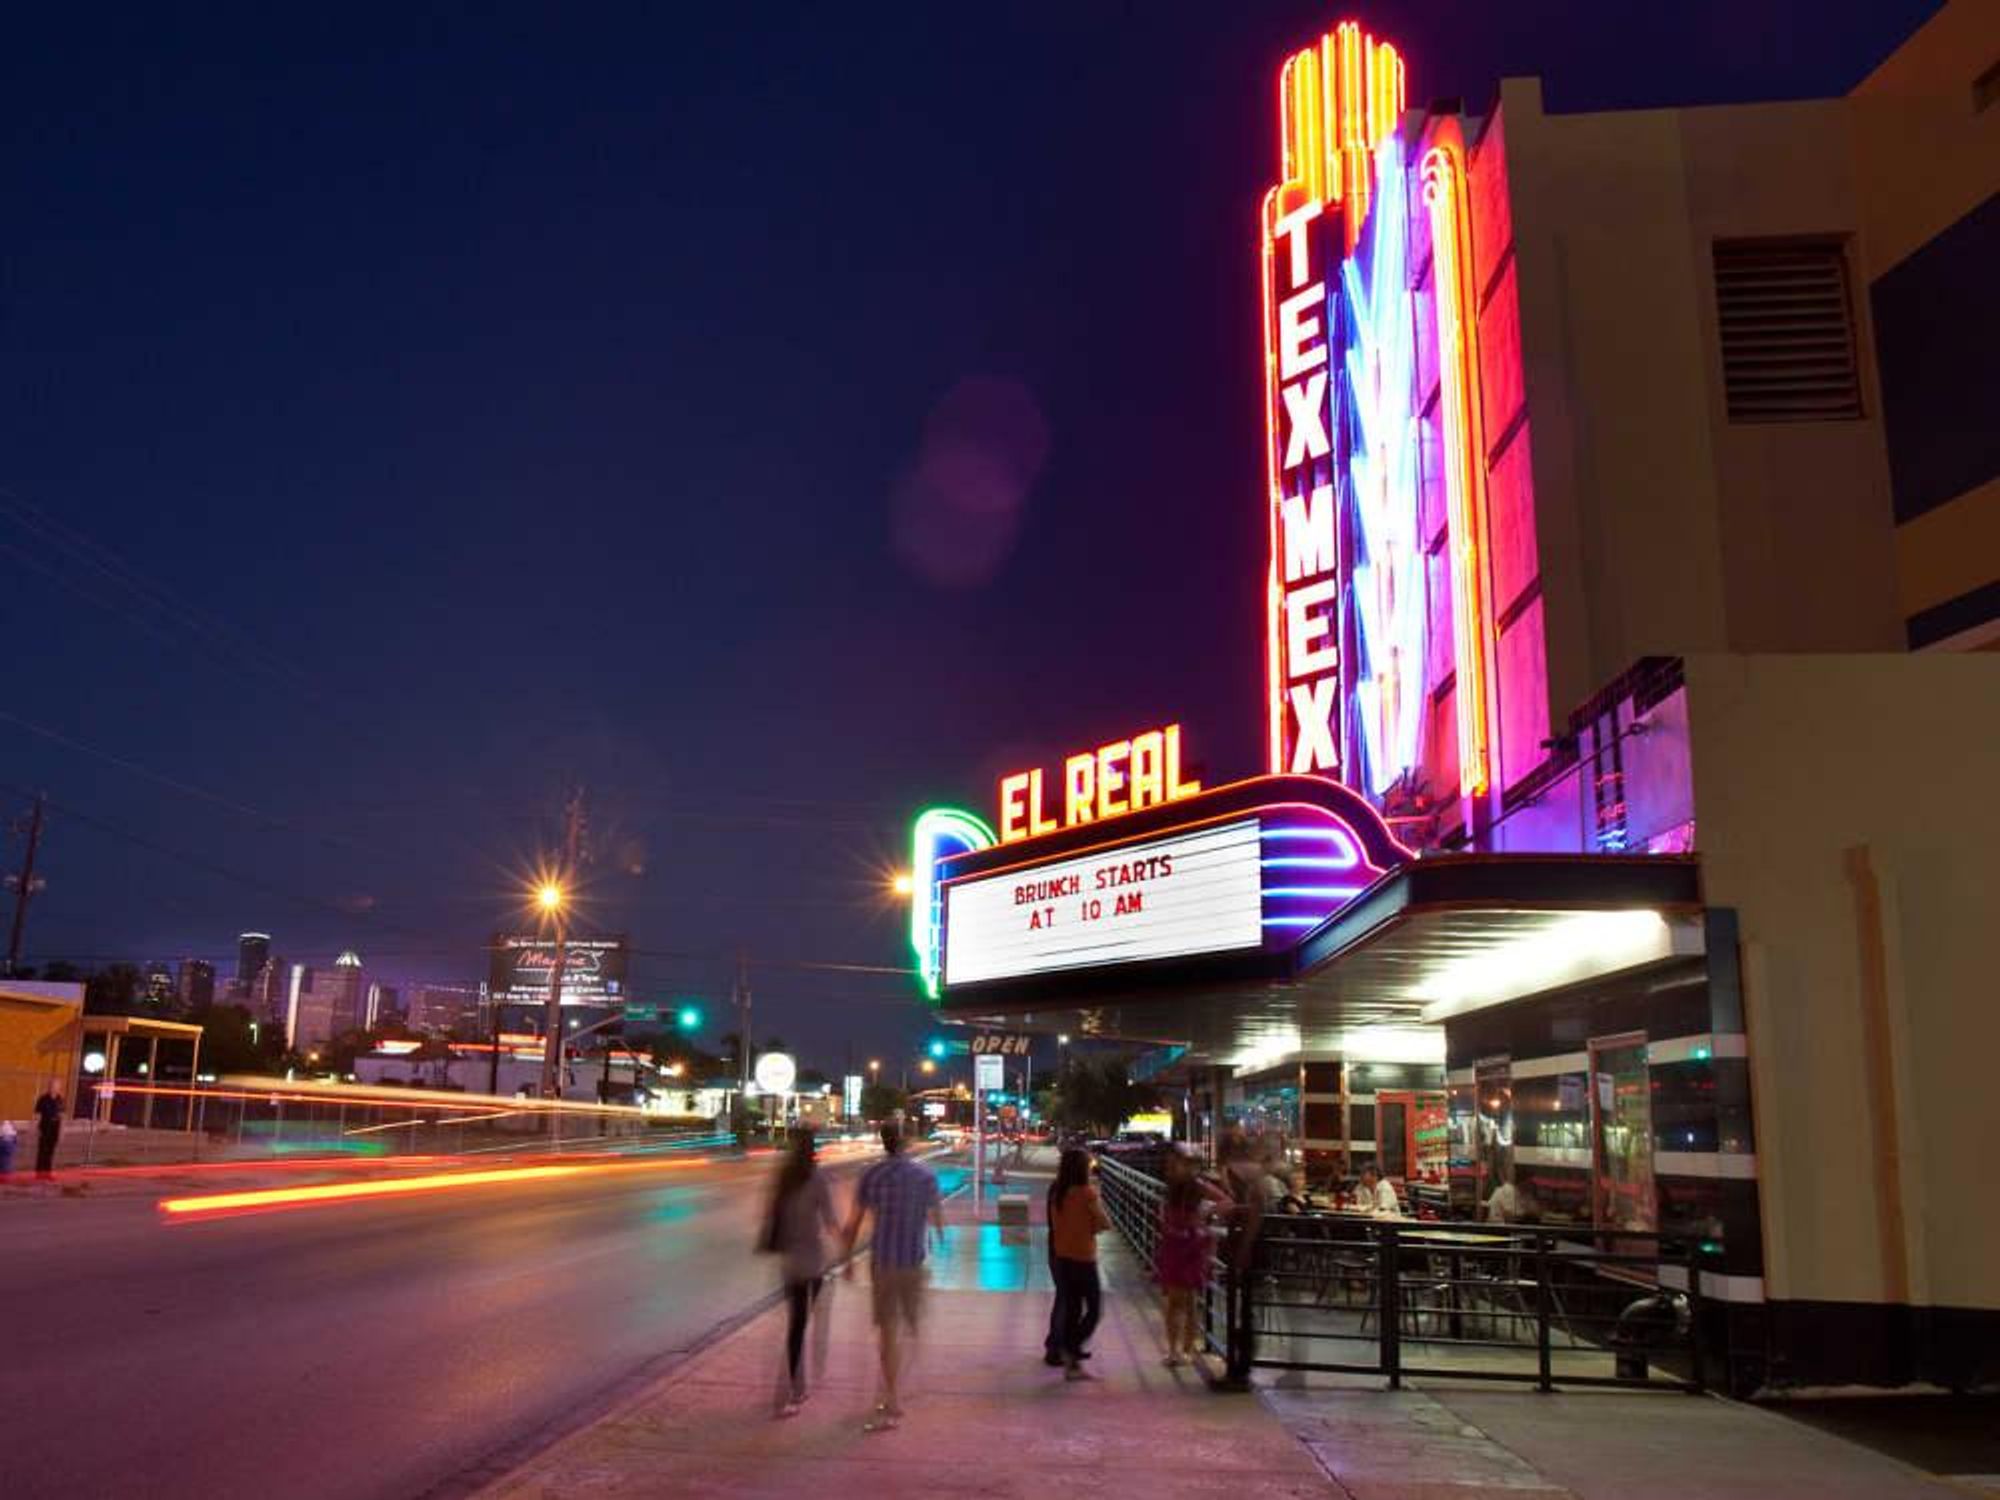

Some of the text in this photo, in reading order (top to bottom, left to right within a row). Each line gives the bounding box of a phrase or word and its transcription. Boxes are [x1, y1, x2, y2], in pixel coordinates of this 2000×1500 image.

[1275, 201, 1339, 774] TEX MEX
[1001, 723, 1201, 844] EL REAL
[1014, 854, 1174, 905] BRUNCH STARTS
[1029, 890, 1143, 930] AT 10 AM
[971, 1034, 1031, 1055] OPEN
